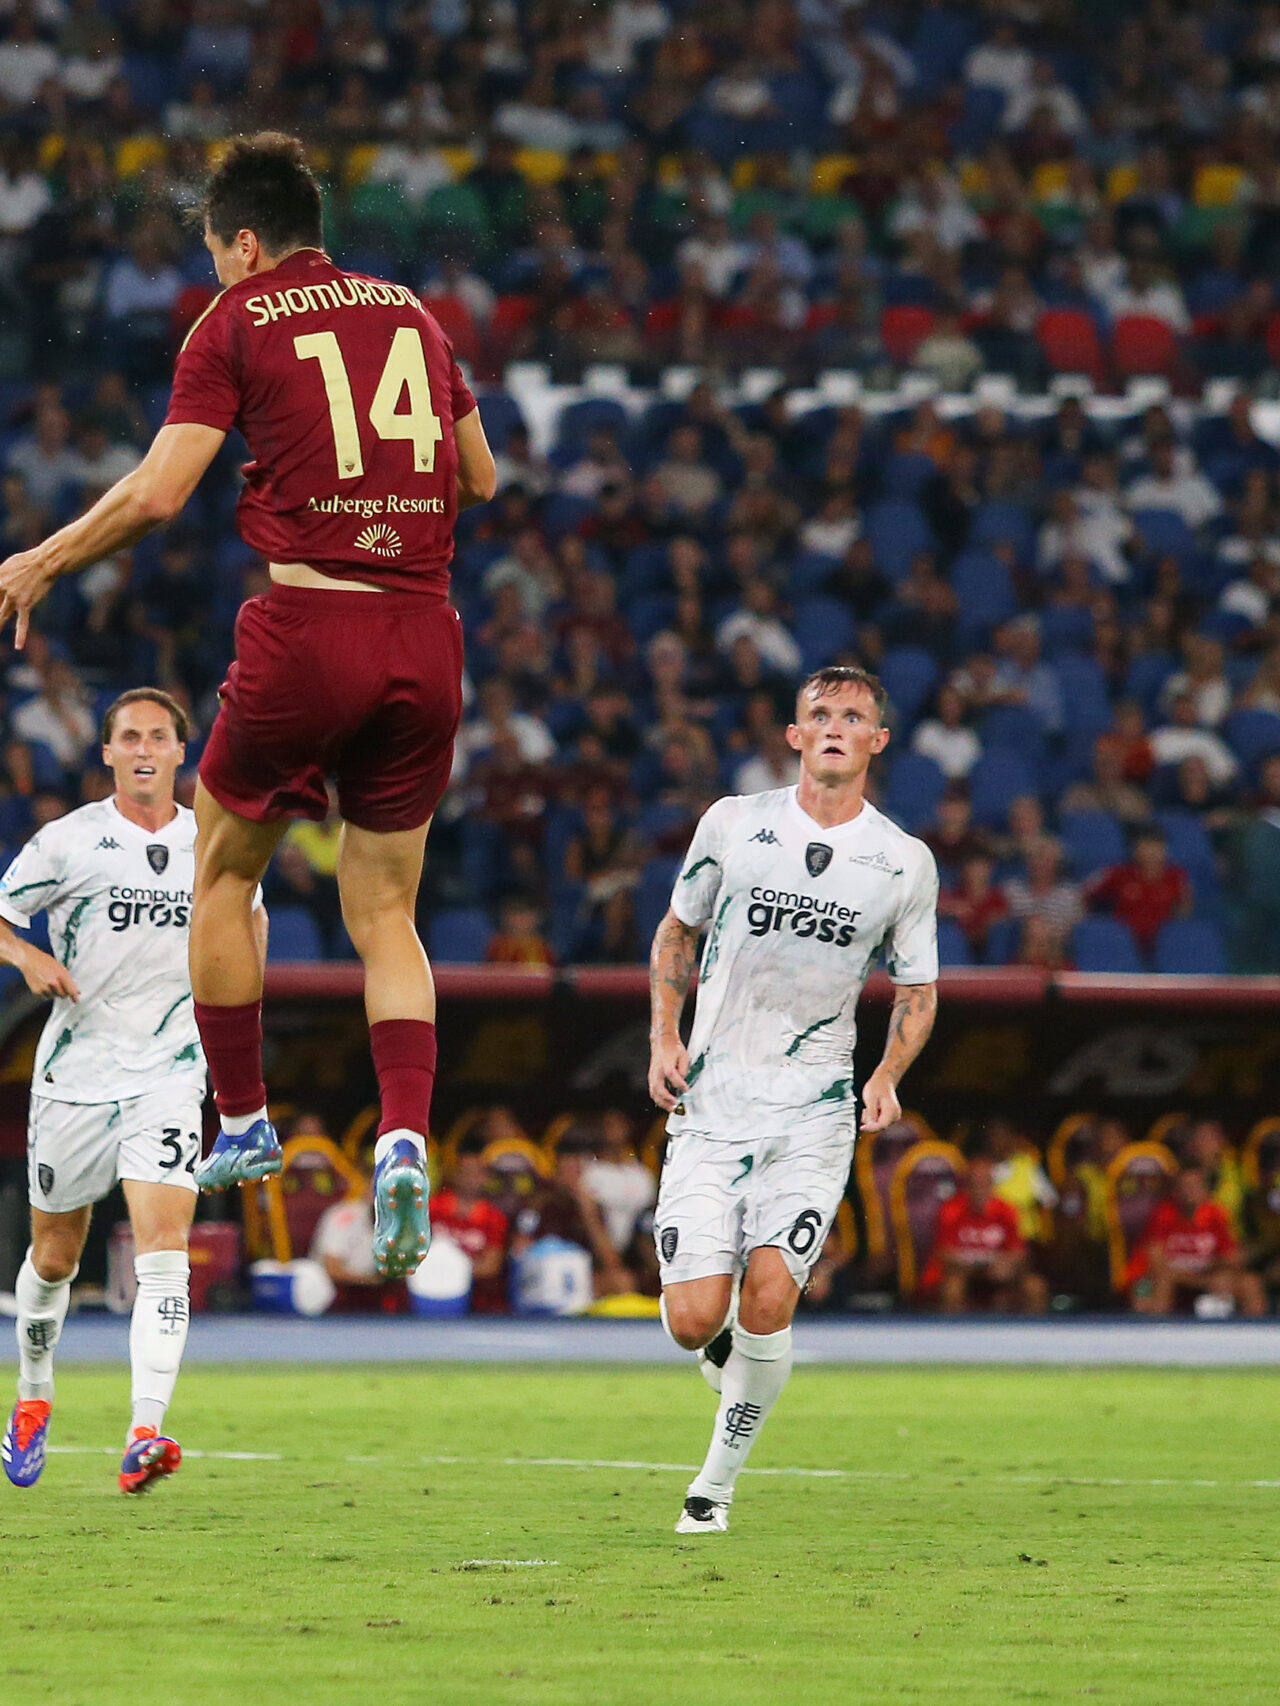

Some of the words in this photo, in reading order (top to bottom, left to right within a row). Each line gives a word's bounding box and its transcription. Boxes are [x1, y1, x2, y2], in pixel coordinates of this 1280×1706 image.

[245, 277, 426, 327] SHOMURODO
[293, 326, 444, 480] 14
[307, 494, 383, 519] Auberge
[747, 902, 857, 948] gross
[750, 886, 862, 923] computer
[158, 1127, 200, 1174] 32
[788, 1209, 822, 1255] 6
